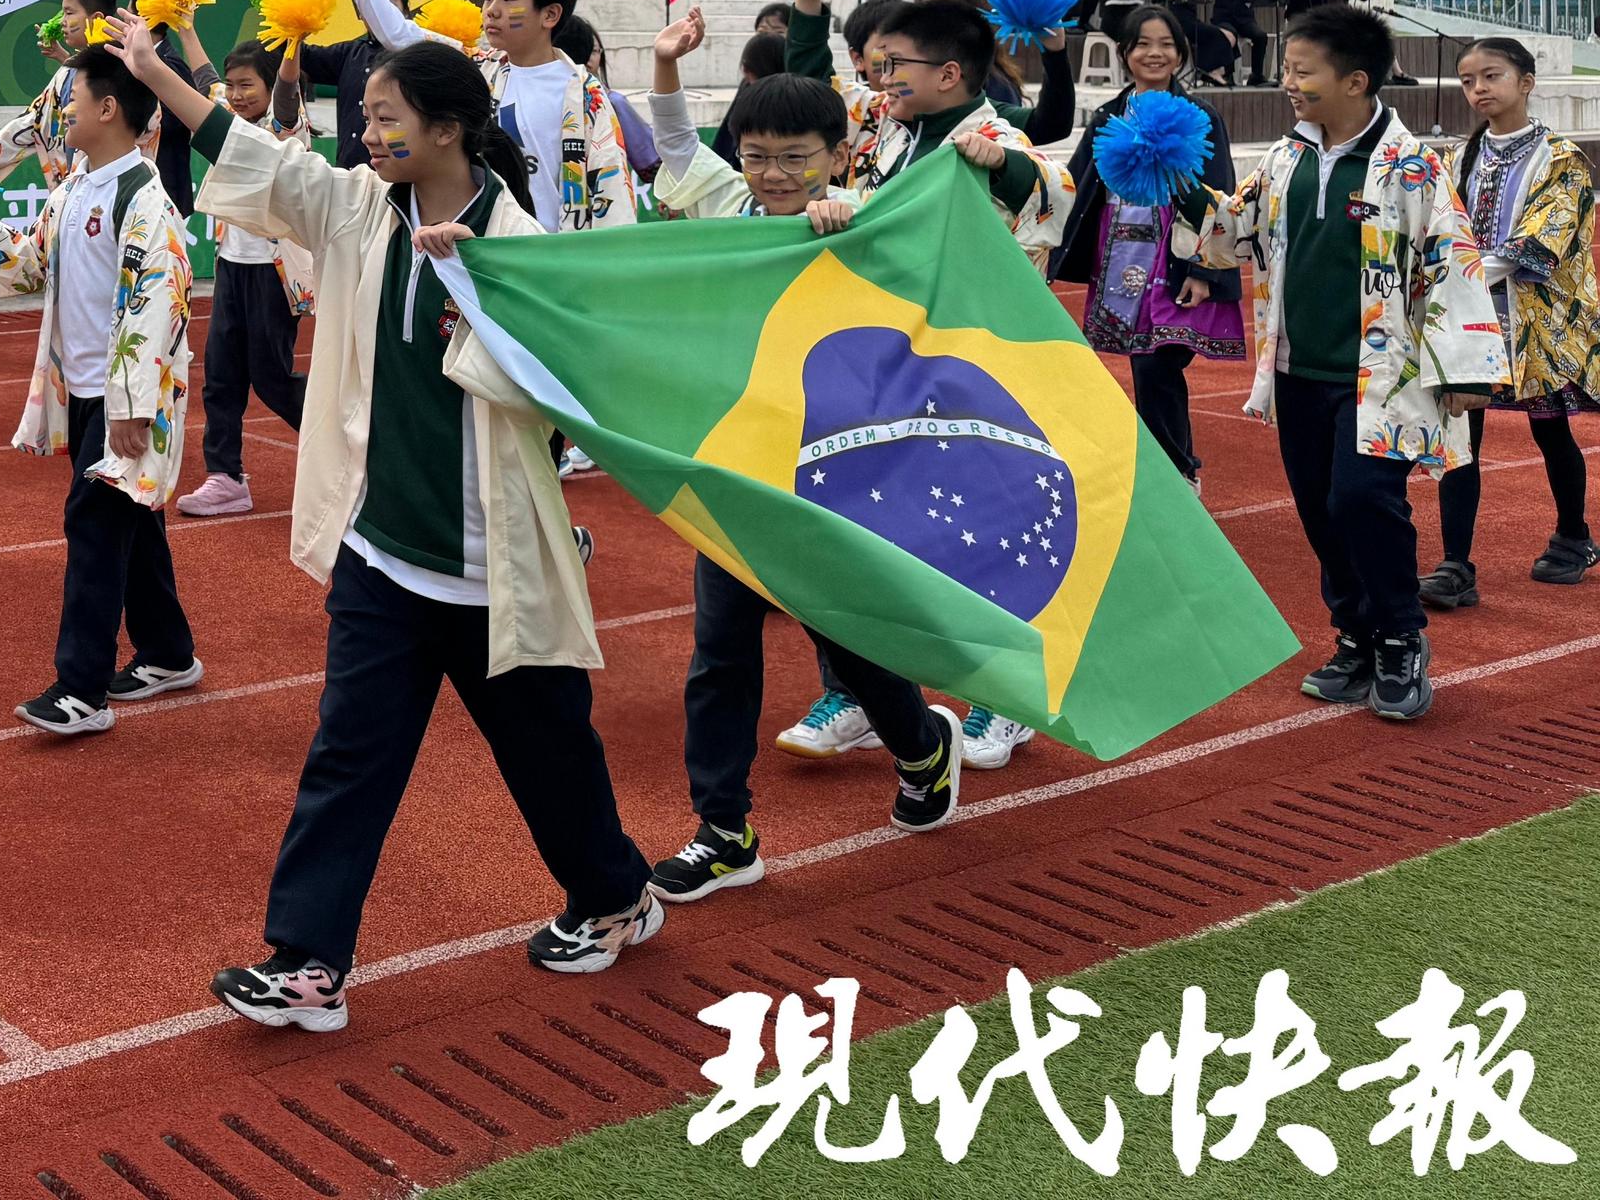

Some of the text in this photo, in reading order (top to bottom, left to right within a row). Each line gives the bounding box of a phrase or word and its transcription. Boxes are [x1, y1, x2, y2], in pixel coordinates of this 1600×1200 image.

[811, 420, 1052, 457] ORDEM E PROGRESSO
